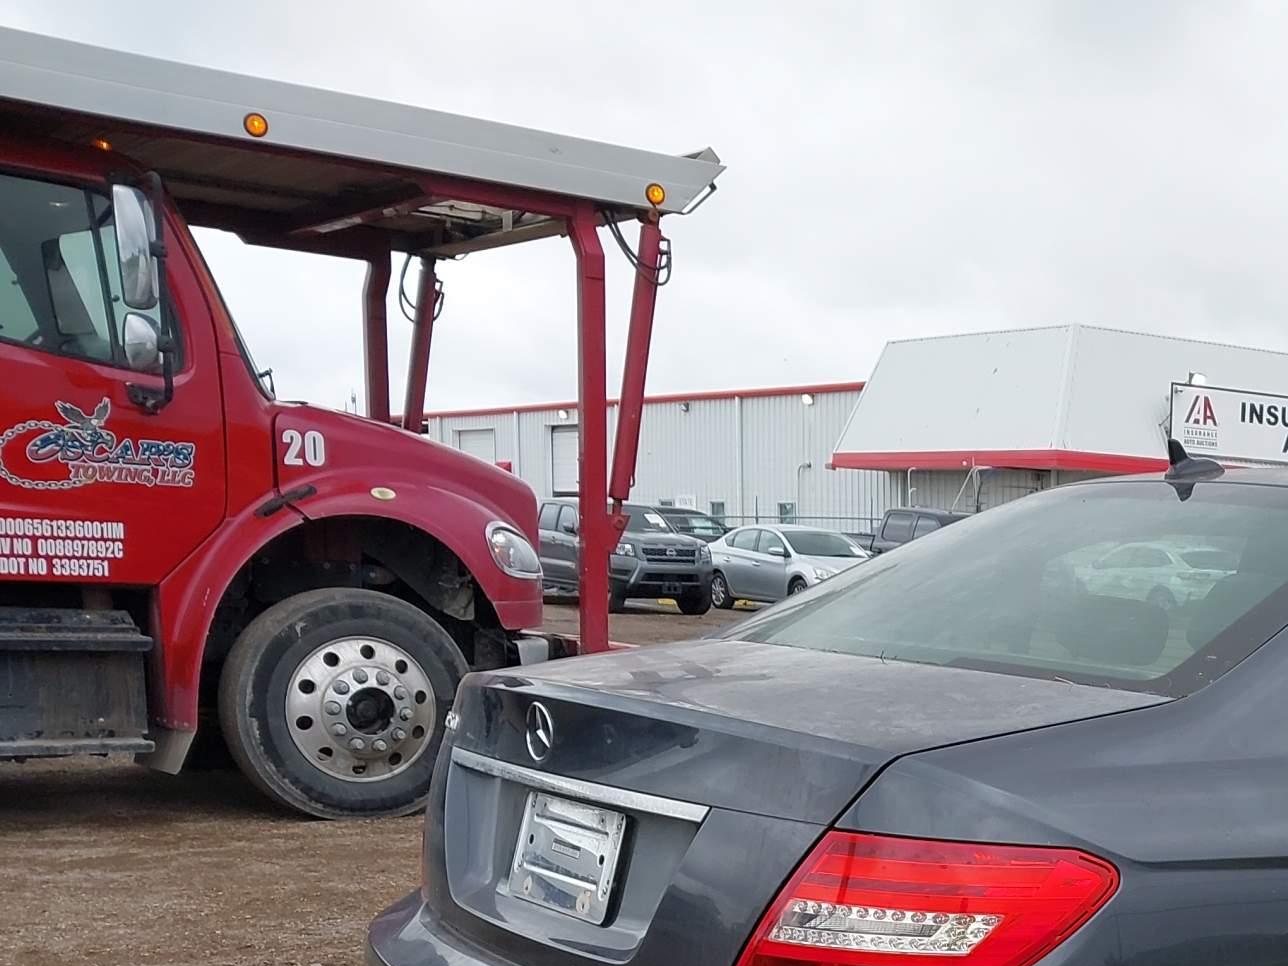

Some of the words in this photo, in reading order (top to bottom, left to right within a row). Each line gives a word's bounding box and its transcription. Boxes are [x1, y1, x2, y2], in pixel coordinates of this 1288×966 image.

[282, 429, 325, 466] 20
[71, 464, 154, 487] TOWING,
[157, 466, 195, 487] LLC
[13, 538, 32, 556] NO
[37, 538, 124, 558] 008897892C
[28, 558, 47, 575] NO
[52, 558, 109, 577] 3393751
